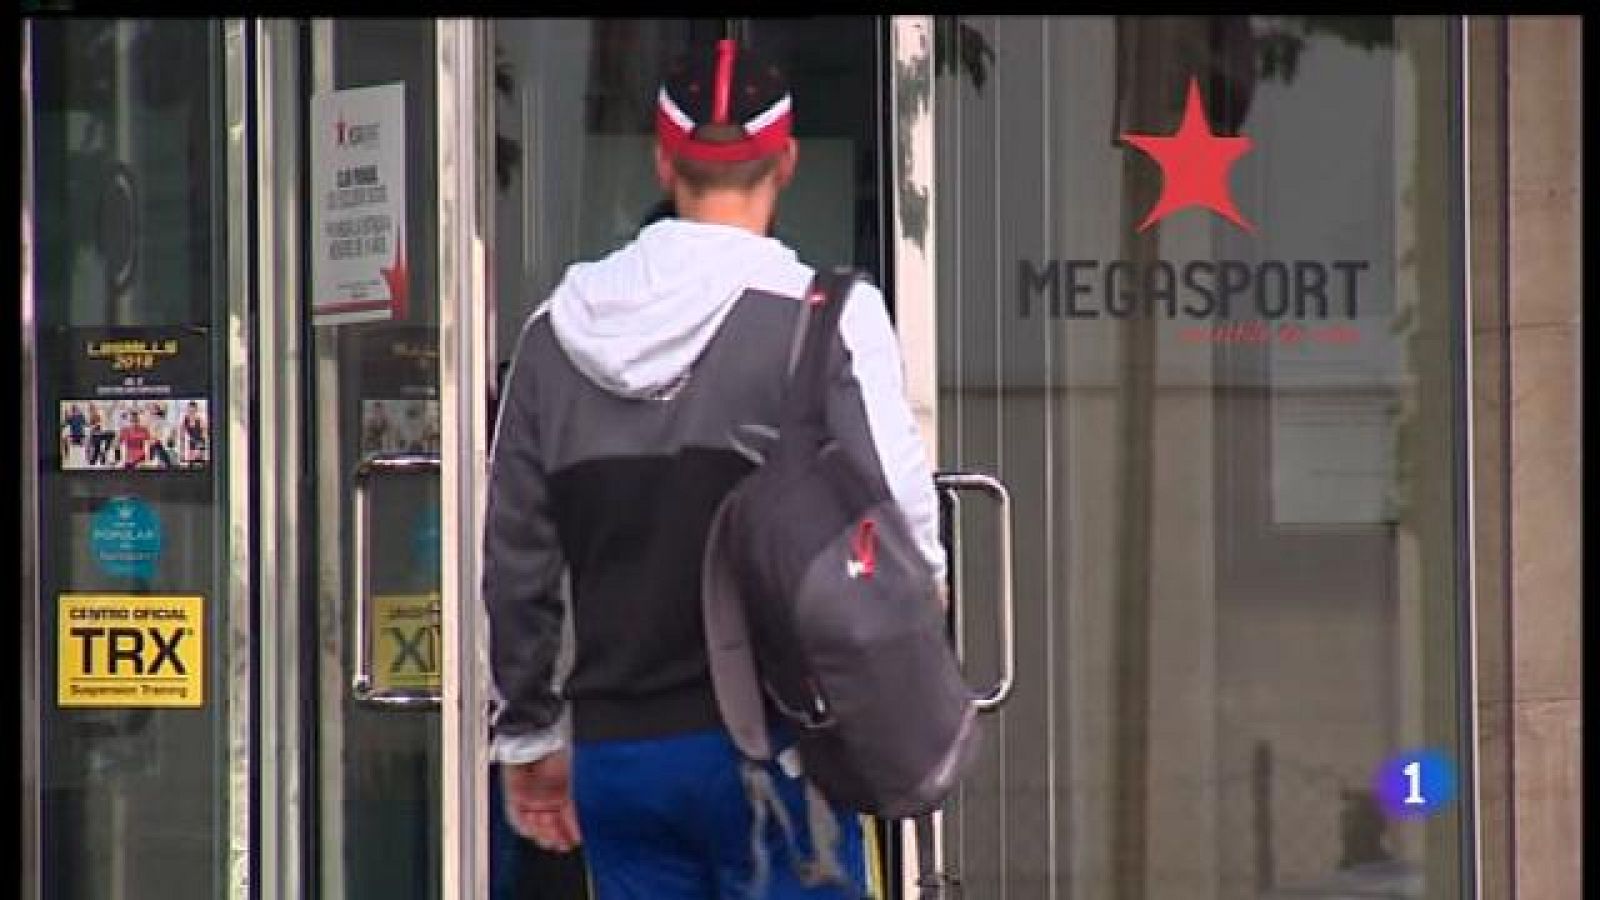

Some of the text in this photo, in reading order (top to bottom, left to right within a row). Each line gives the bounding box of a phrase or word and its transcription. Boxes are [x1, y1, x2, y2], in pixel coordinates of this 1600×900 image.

[1017, 259, 1370, 319] MEGASPORT
[69, 605, 187, 620] CENTRO OFICIAL
[70, 627, 187, 675] TRX
